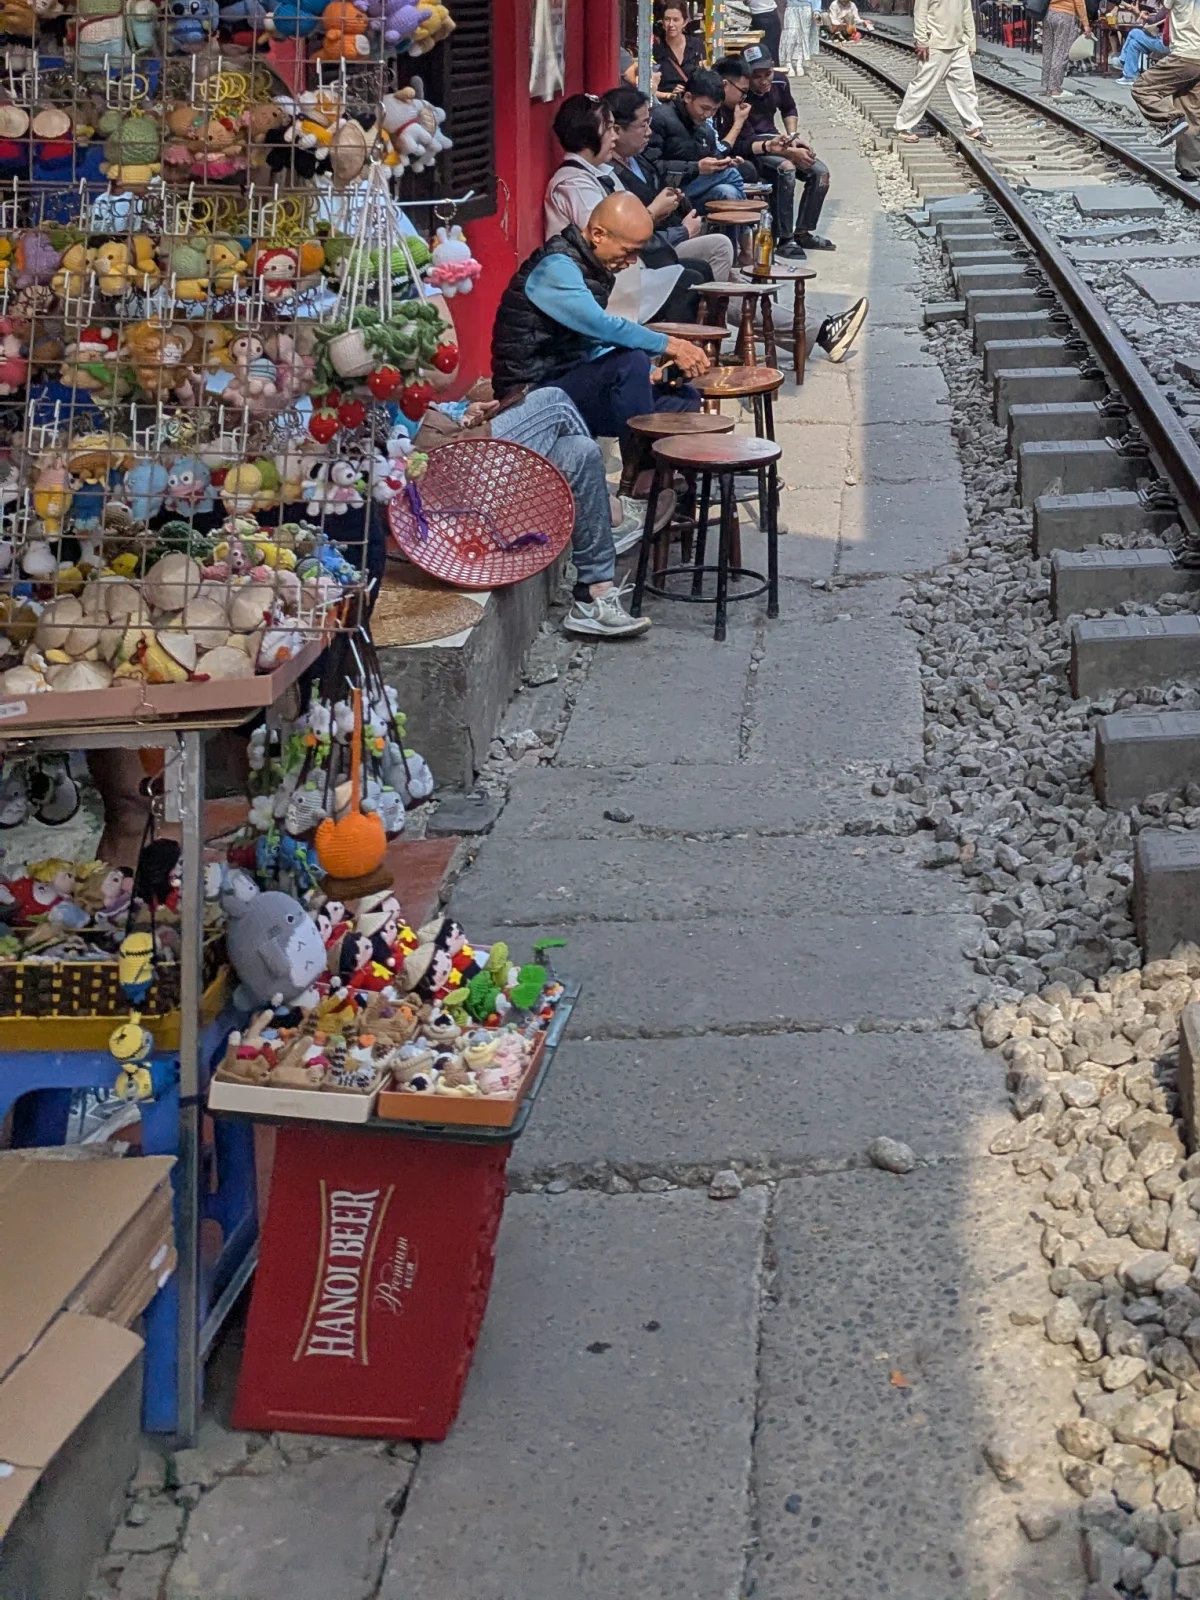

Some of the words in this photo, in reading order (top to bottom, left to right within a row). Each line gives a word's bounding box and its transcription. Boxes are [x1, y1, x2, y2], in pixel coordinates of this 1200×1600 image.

[328, 1188, 380, 1260] BEER
[305, 1265, 361, 1359] HANOI
[372, 1234, 410, 1317] Premium
